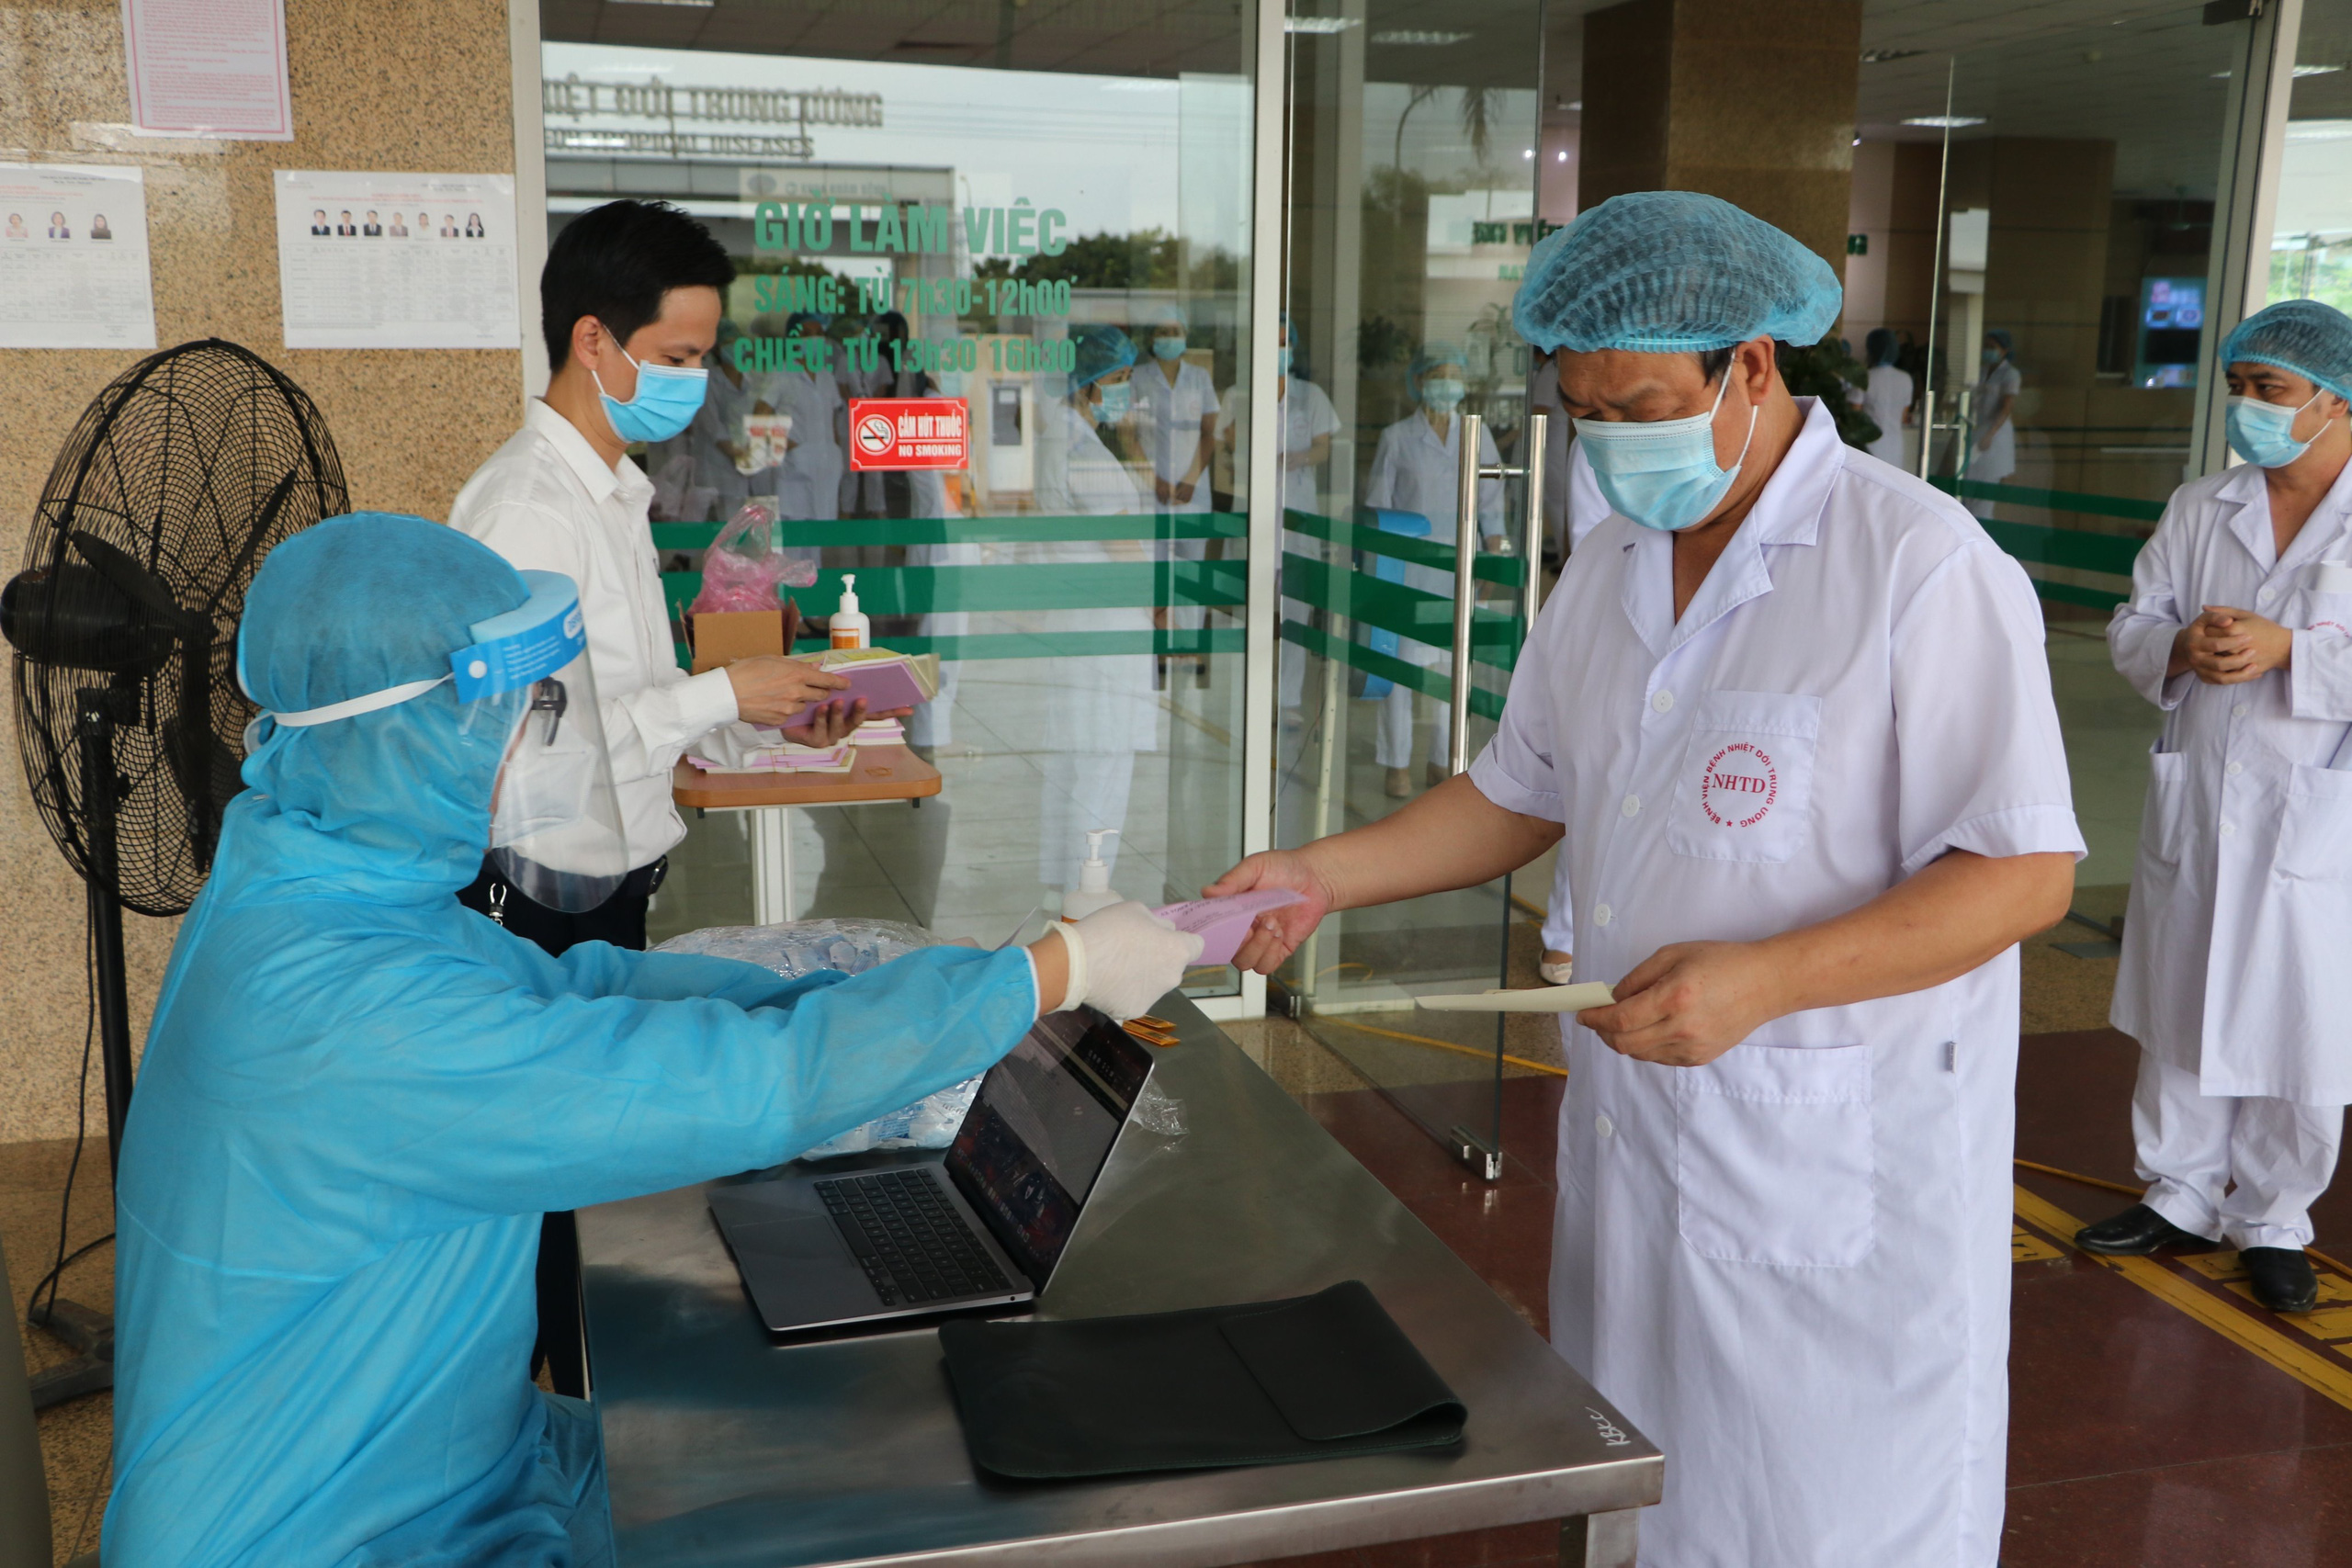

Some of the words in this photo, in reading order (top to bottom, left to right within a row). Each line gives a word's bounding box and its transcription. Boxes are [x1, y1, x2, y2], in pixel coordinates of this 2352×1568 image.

[689, 87, 790, 122] TRUNG
[754, 189, 837, 251] GIỜ
[850, 191, 948, 254] LÀM
[963, 197, 1067, 265] VIỆC
[754, 266, 846, 313] SÁNG:
[855, 266, 893, 314] TỪ
[734, 323, 834, 373] CHIỀU:
[843, 327, 881, 373] TỪ
[918, 412, 933, 438] HÚT
[899, 445, 913, 457] NO
[915, 444, 962, 457] SMOKING
[1712, 773, 1766, 794] NHTD
[1766, 767, 1778, 806] TRUNG
